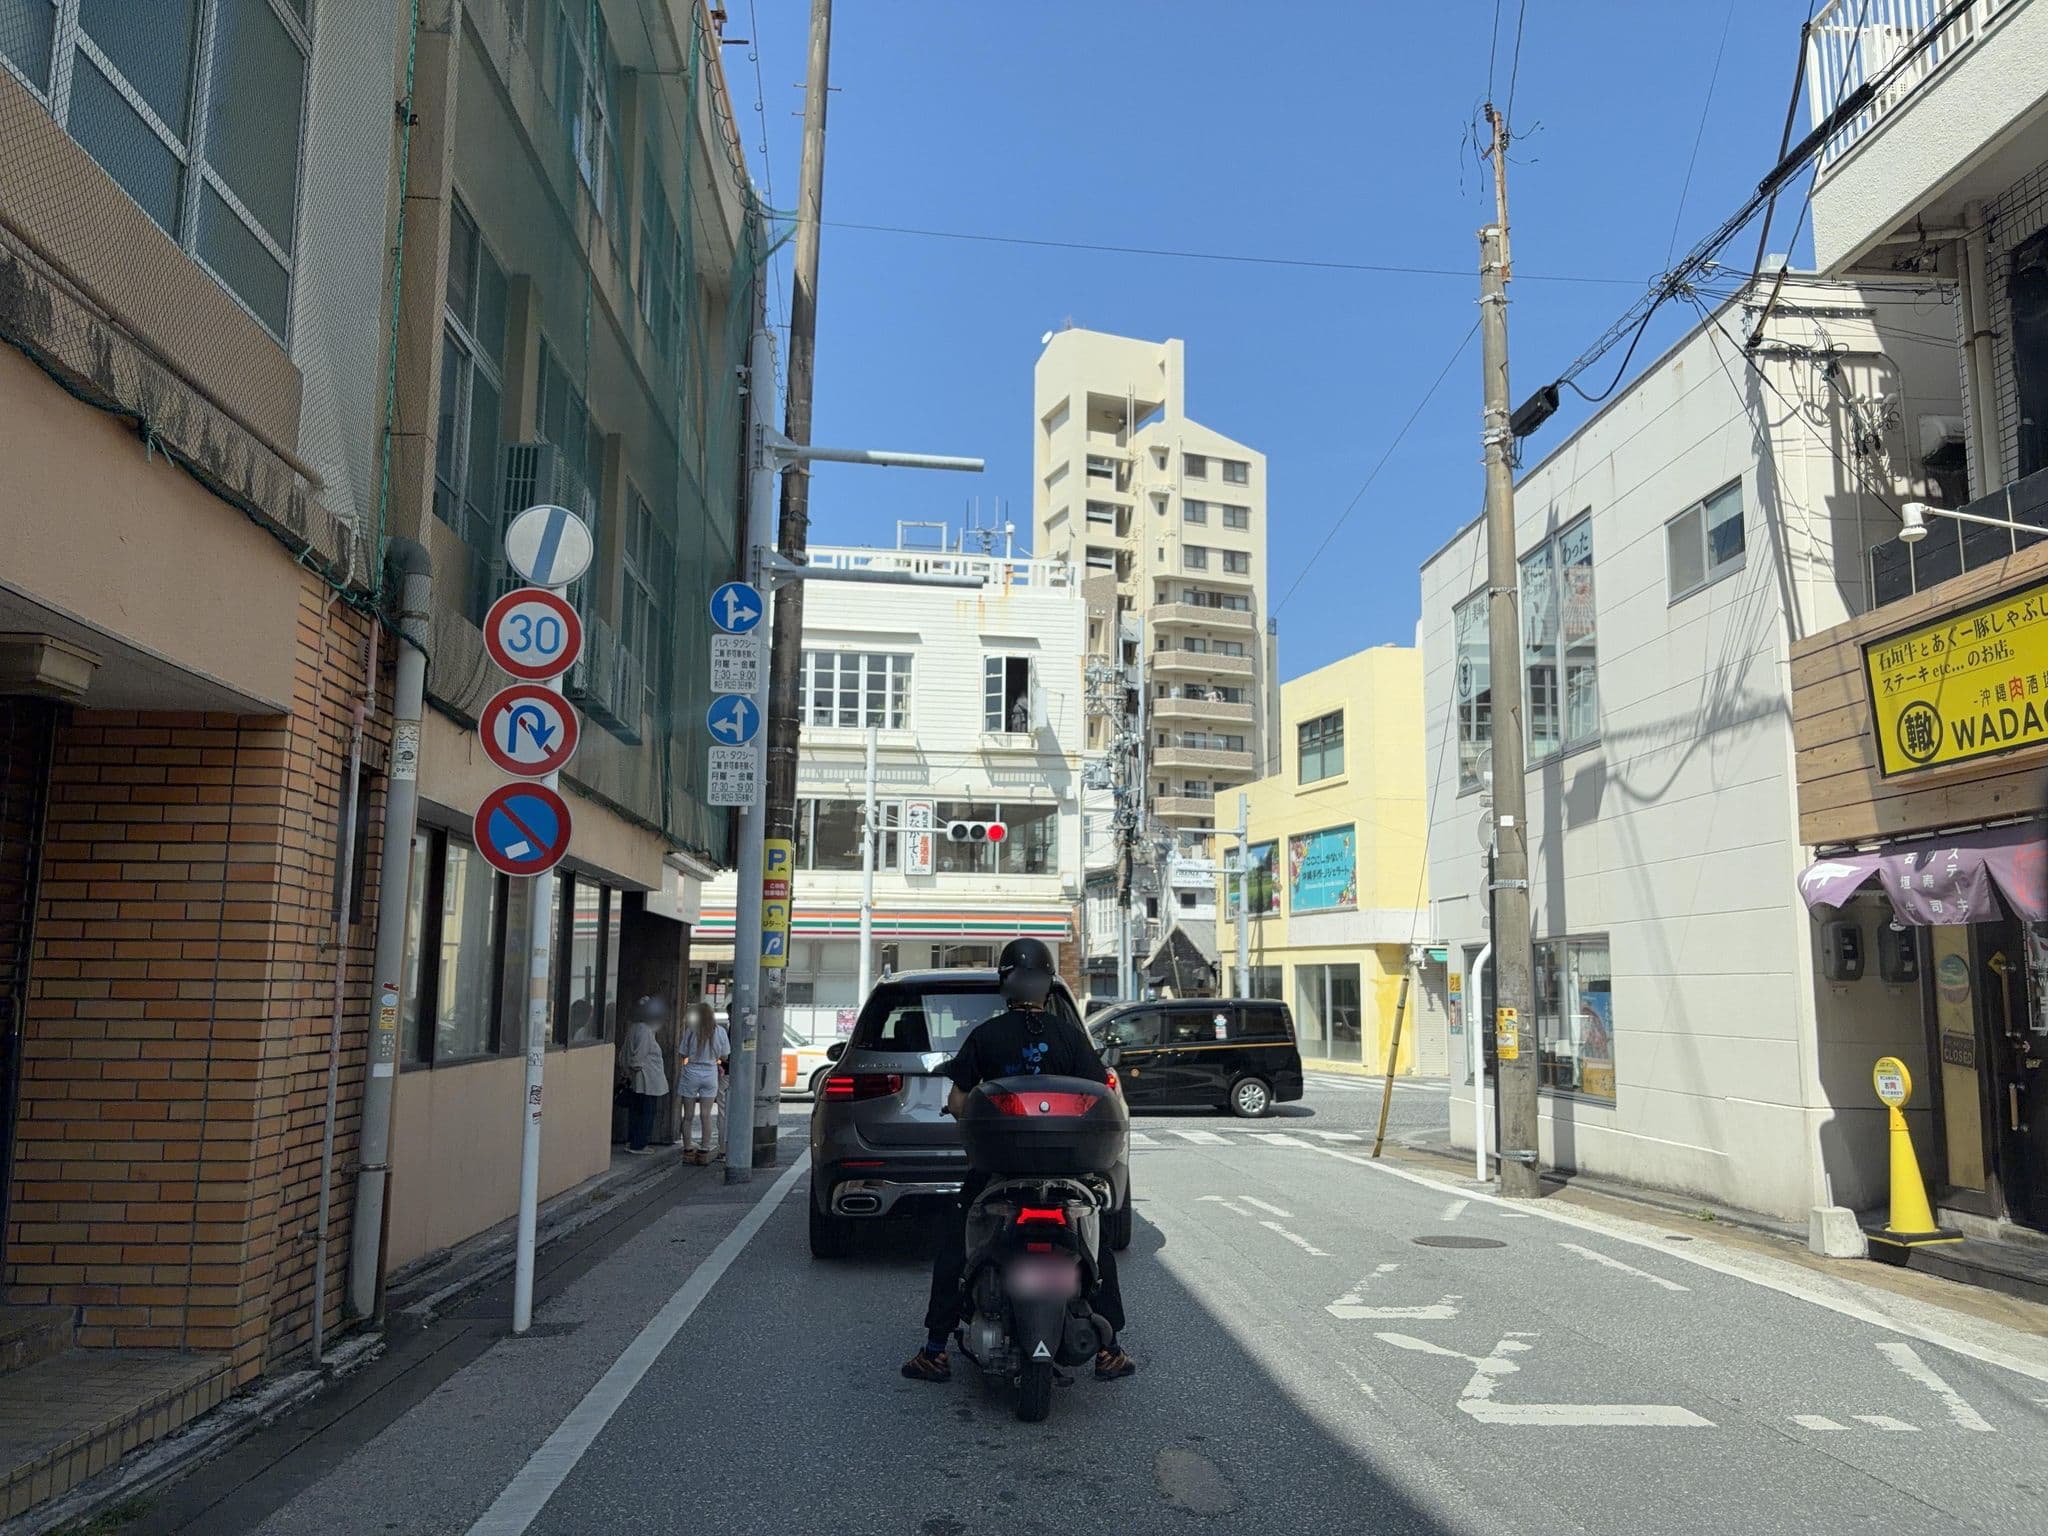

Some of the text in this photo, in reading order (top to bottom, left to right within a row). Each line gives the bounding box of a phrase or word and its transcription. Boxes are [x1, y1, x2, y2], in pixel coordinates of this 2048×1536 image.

[508, 614, 560, 654] 30
[1951, 700, 2048, 750] WADA
[1946, 848, 1969, 913] ステーキ
[1944, 1048, 1973, 1065] CLOSED
